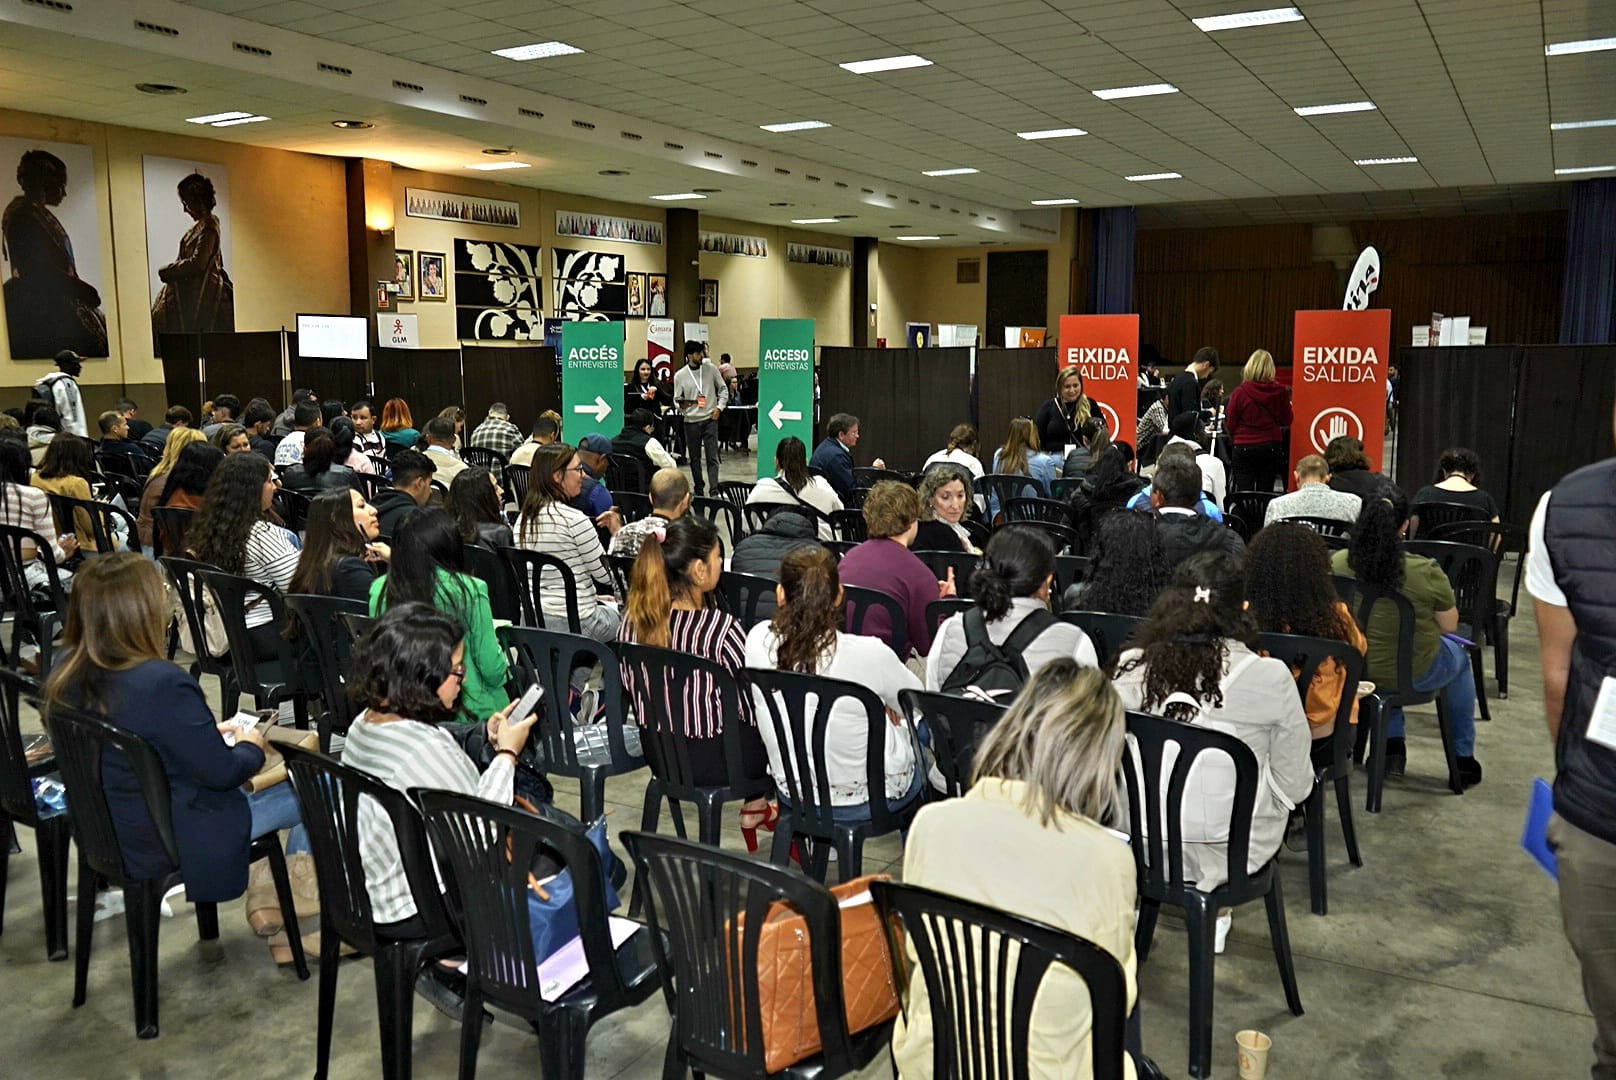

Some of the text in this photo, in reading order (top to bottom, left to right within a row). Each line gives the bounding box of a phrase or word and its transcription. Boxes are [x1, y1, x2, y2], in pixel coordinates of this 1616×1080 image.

[568, 344, 618, 360] ACCÉS
[764, 348, 809, 361] ACCESO
[1067, 347, 1130, 364] EIXIDA
[1303, 346, 1378, 364] EIXIDA
[568, 360, 618, 370] ENTREVISTES
[764, 361, 809, 371] ENTREVISTAS
[1074, 364, 1129, 380] ALIDA
[1303, 365, 1377, 382] SALIDA
